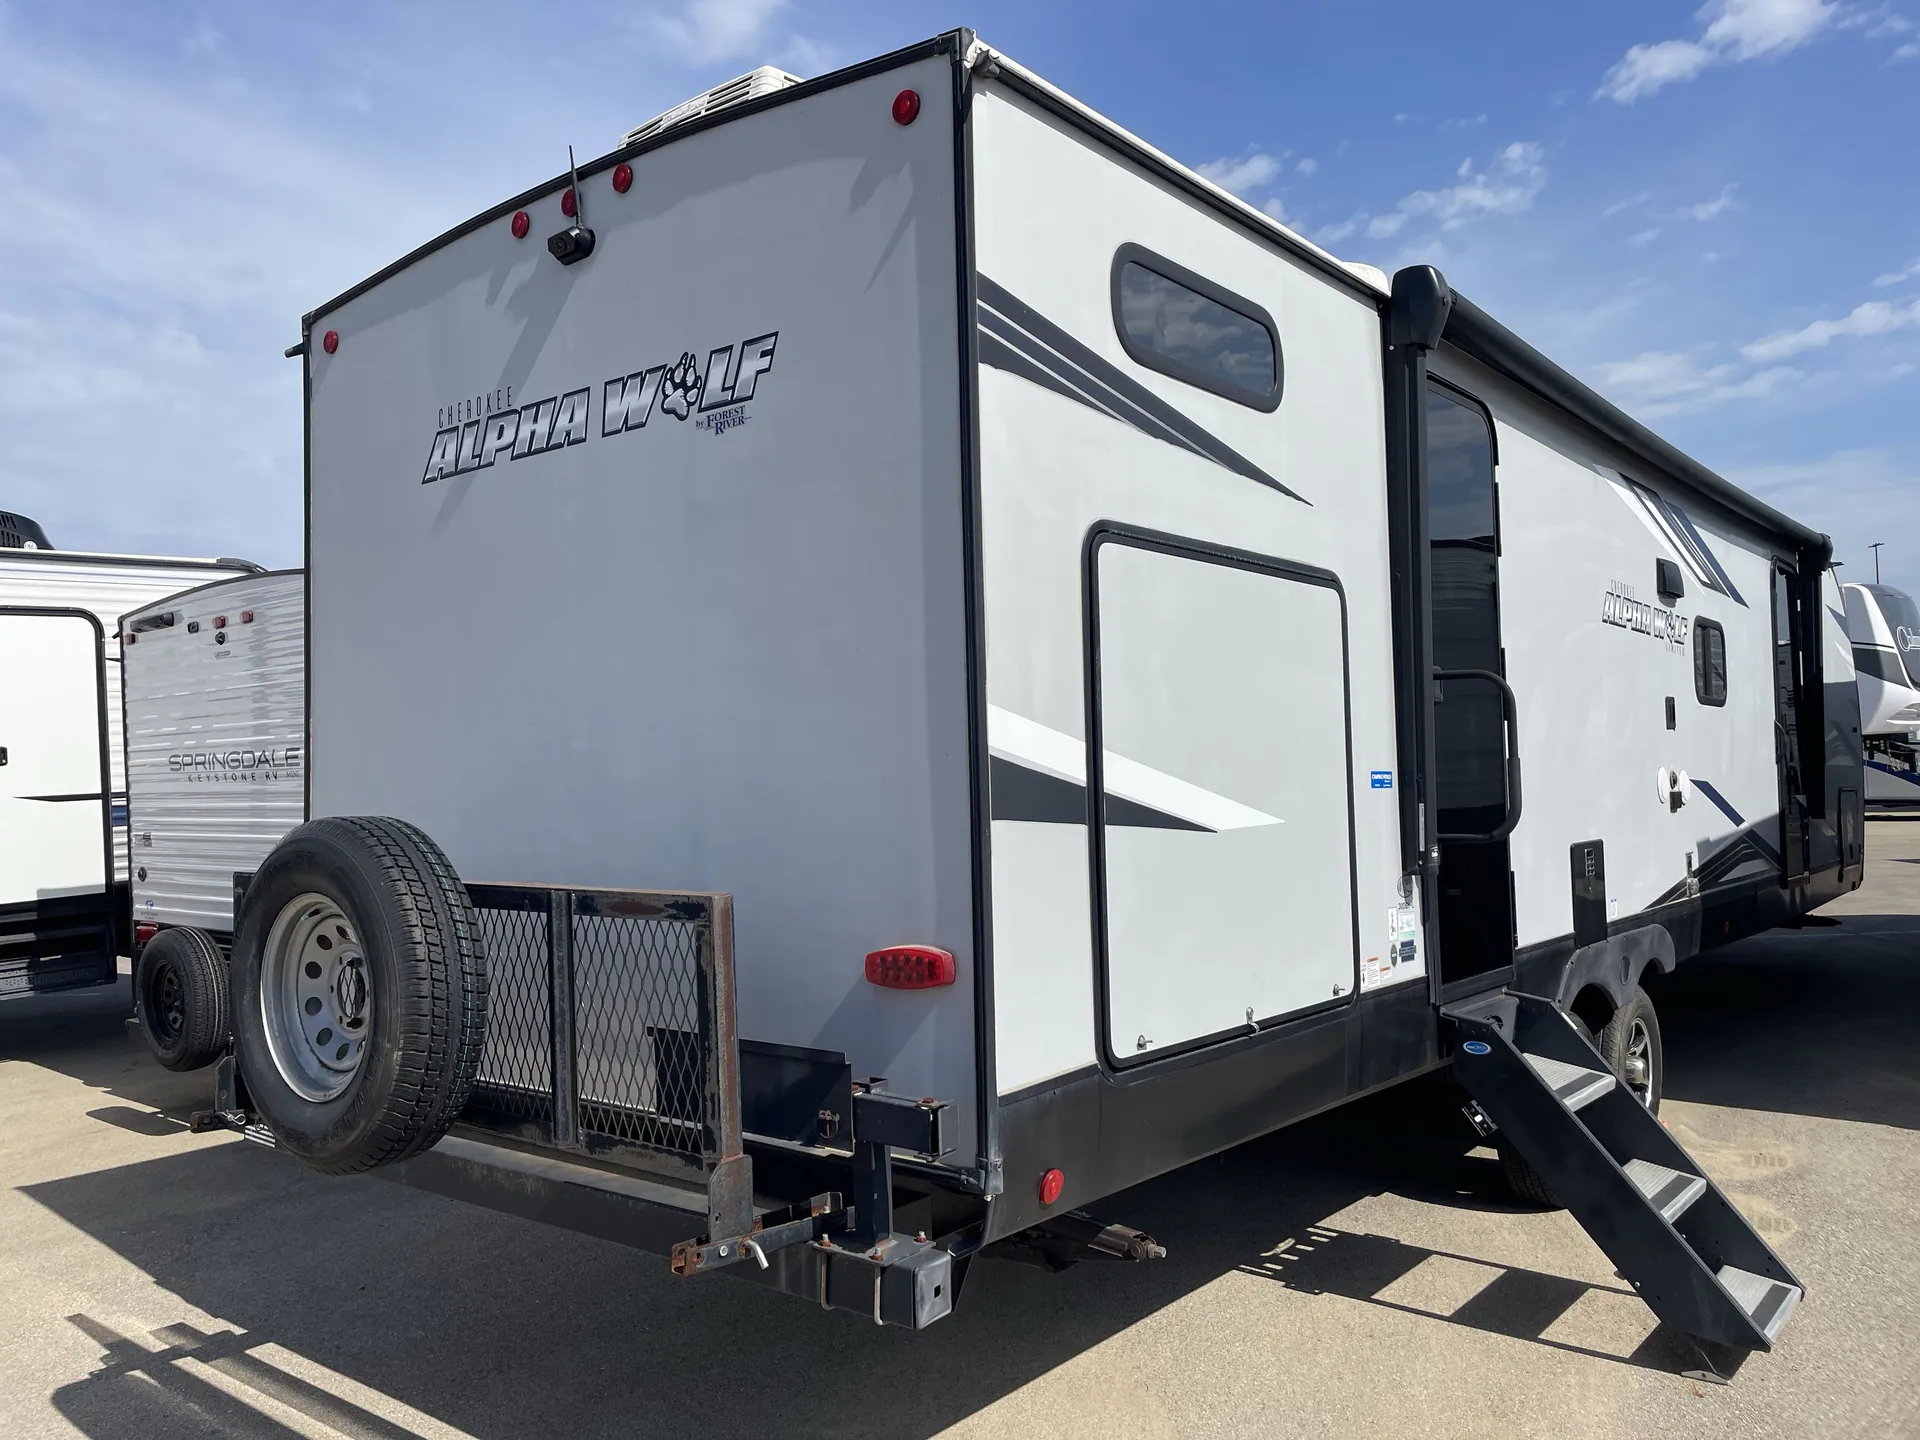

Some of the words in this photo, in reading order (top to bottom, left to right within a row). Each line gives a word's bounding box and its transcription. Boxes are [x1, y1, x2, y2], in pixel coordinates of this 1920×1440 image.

[438, 385, 513, 429] CHEROKEE
[706, 405, 746, 428] FOREST
[421, 386, 591, 485] ALPHA
[714, 415, 746, 436] RIVER
[1601, 590, 1652, 636] ALPHA
[168, 747, 301, 772] SPRINGDALE
[187, 772, 257, 783] KEYSTONE
[265, 771, 279, 781] RV
